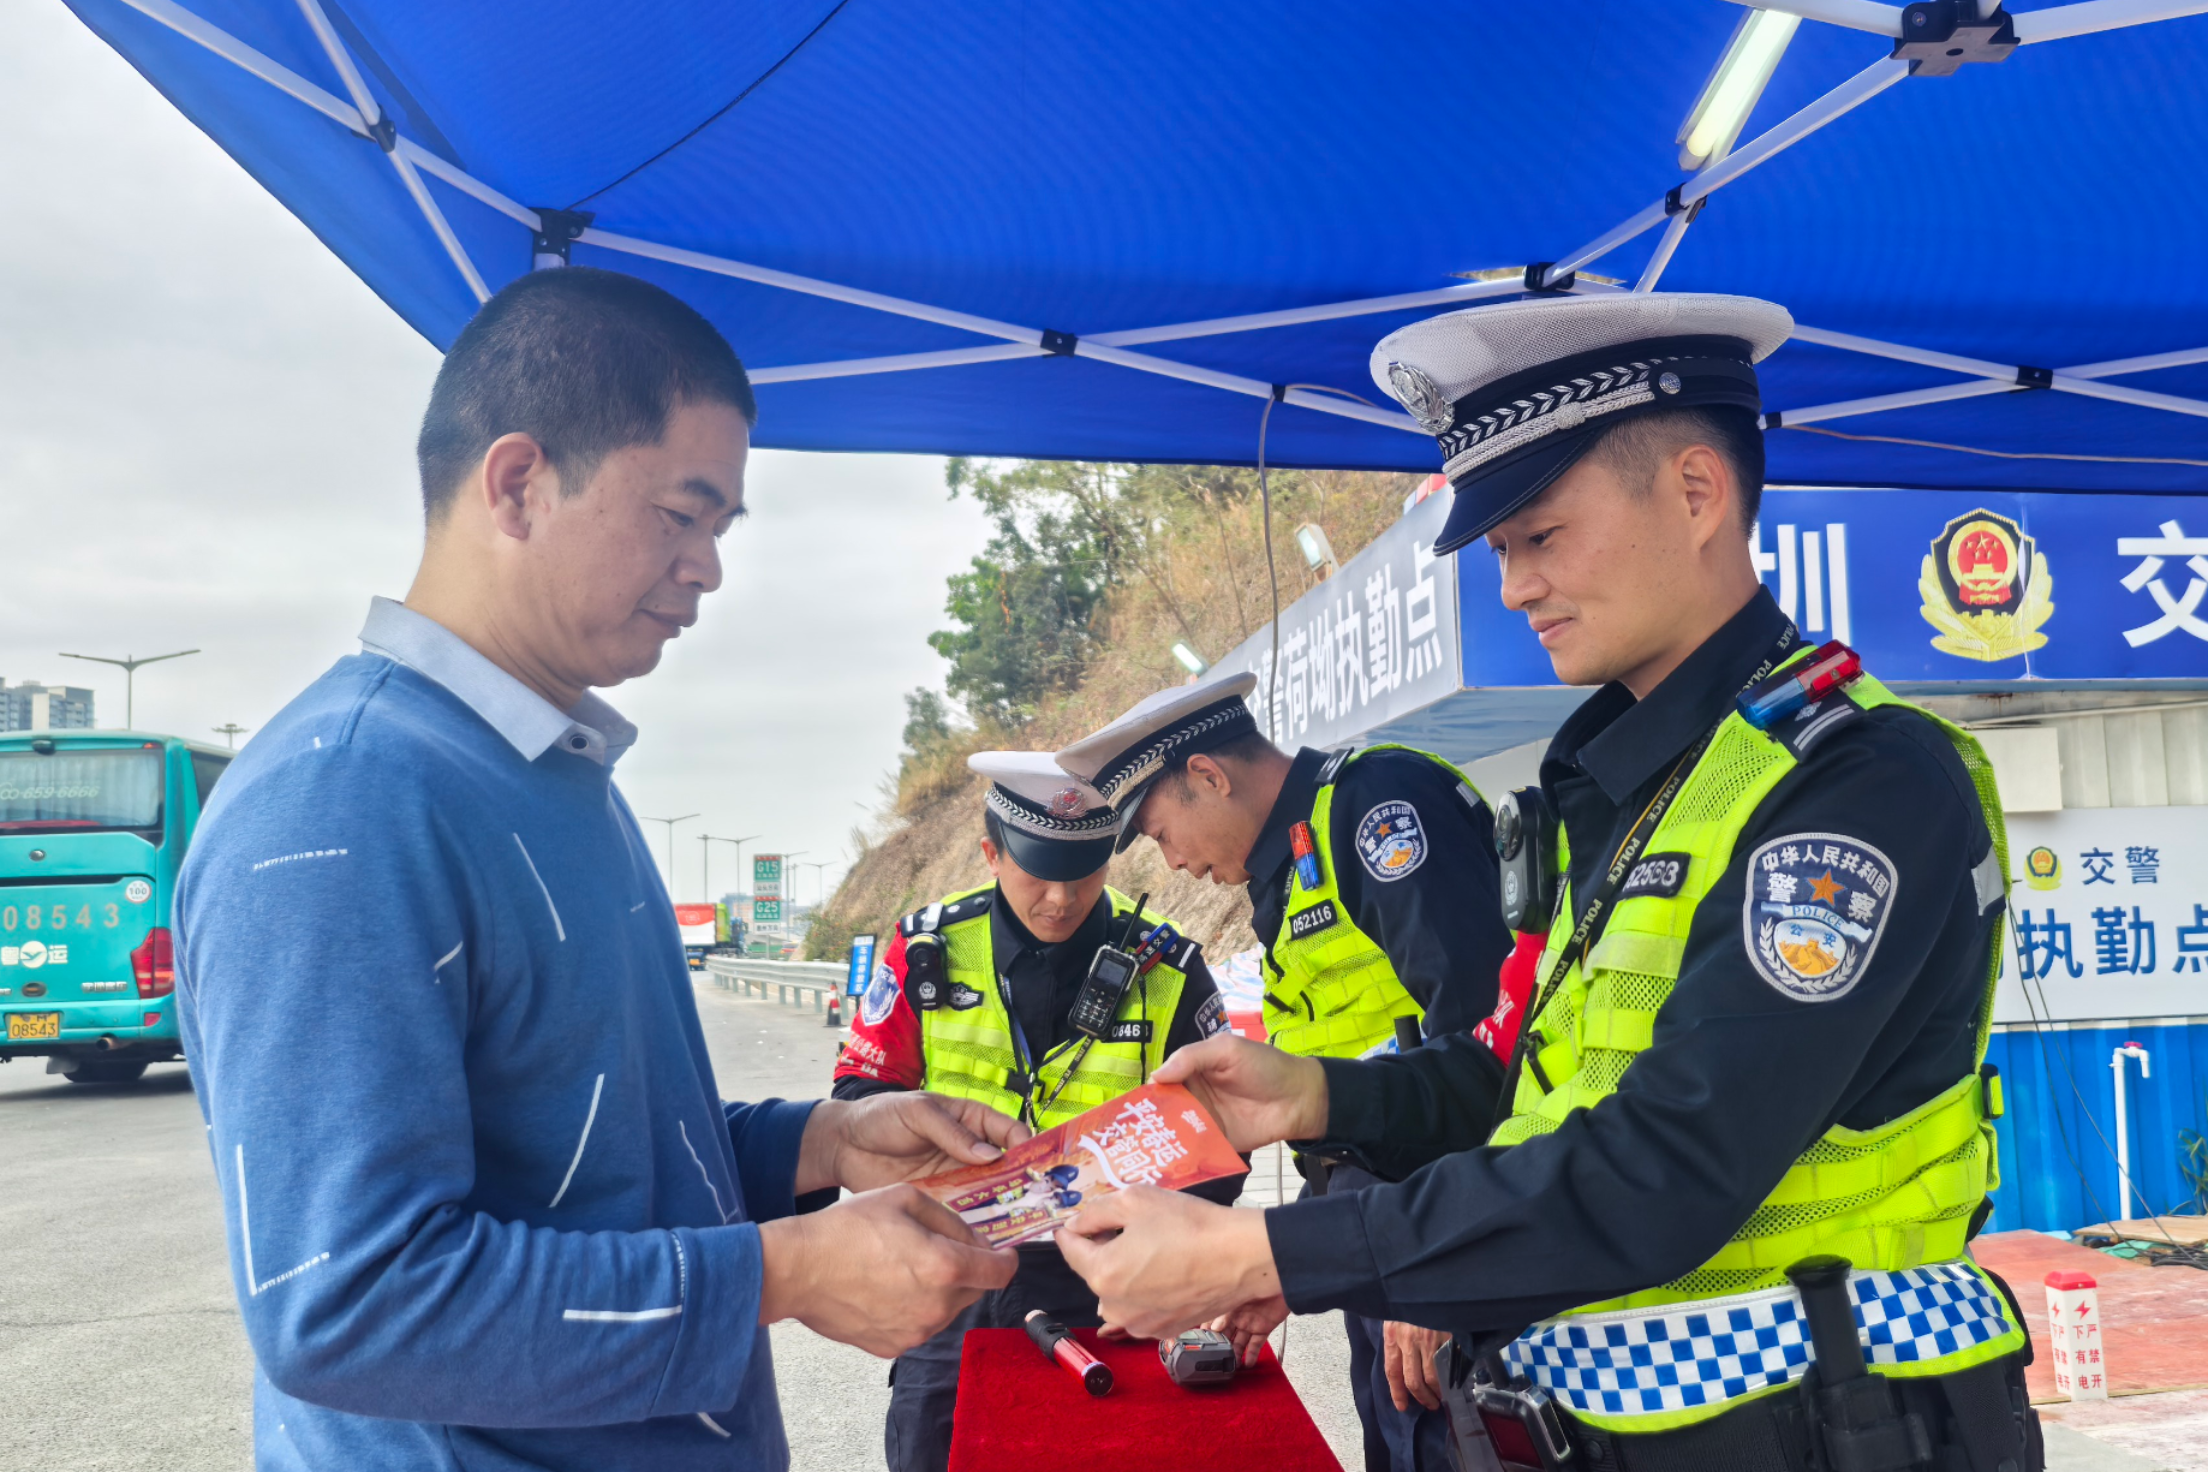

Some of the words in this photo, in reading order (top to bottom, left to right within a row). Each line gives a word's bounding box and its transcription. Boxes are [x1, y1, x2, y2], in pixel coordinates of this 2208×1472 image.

[2117, 520, 2208, 648] 交
[1647, 776, 1680, 822] POLICE
[757, 861, 779, 873] G15
[1607, 837, 1641, 885] POLICE
[1762, 844, 1891, 898] 中华人民共和国
[2079, 847, 2160, 886] 交警
[756, 902, 778, 913] G25
[1293, 905, 1332, 934] 052116
[1766, 872, 1798, 903] 警
[1848, 891, 1877, 923] 察
[1792, 905, 1846, 931] POLICE
[1571, 899, 1604, 945] POLICE
[1998, 904, 2208, 980] 执勤点
[12, 1023, 56, 1037] 08543
[1092, 1121, 1163, 1185] 交管同行
[1115, 1098, 1188, 1168] 平安春运
